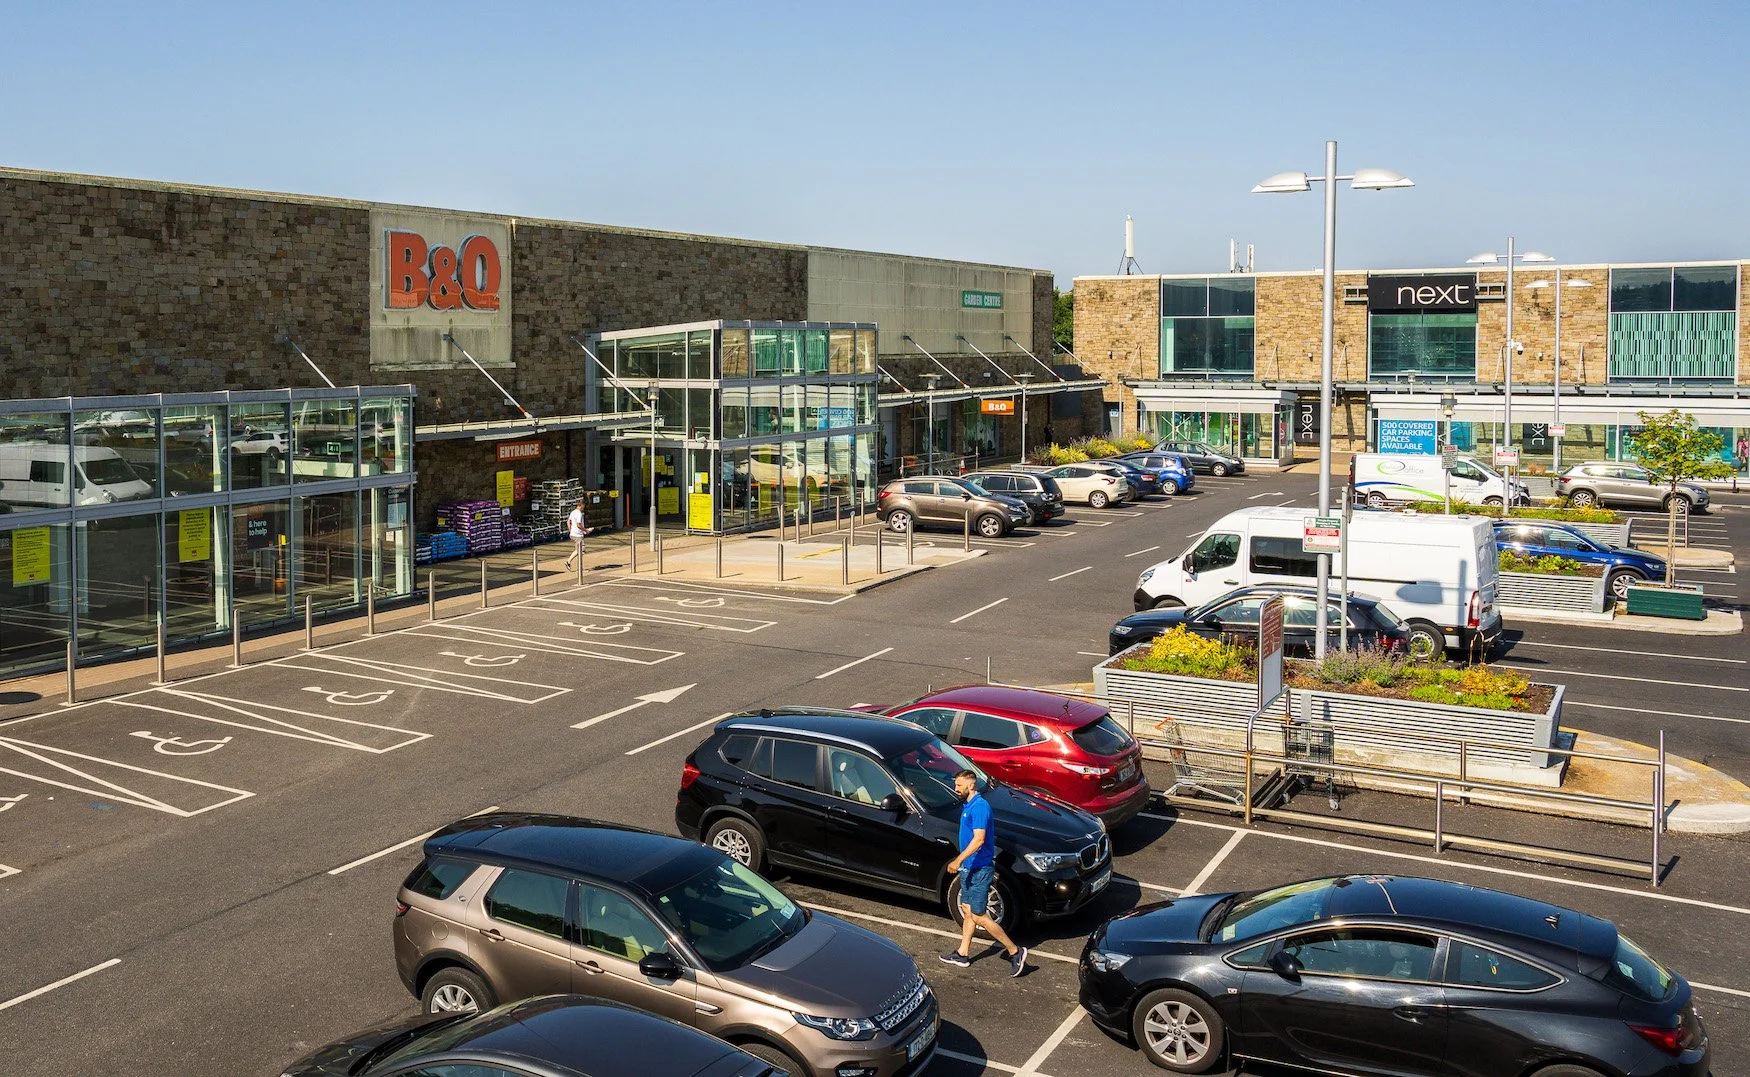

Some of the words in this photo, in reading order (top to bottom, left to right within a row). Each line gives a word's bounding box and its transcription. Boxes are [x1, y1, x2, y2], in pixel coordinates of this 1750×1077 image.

[385, 230, 501, 311] B&Q
[964, 294, 982, 306] GARDEN
[983, 295, 1001, 307] CENTRE
[1397, 284, 1469, 305] next
[988, 403, 1006, 412] B&Q
[1301, 404, 1313, 439] next
[1531, 423, 1545, 446] ext
[499, 443, 539, 459] ENTRANCE
[253, 520, 267, 528] here
[248, 529, 255, 537] to
[254, 528, 268, 537] help
